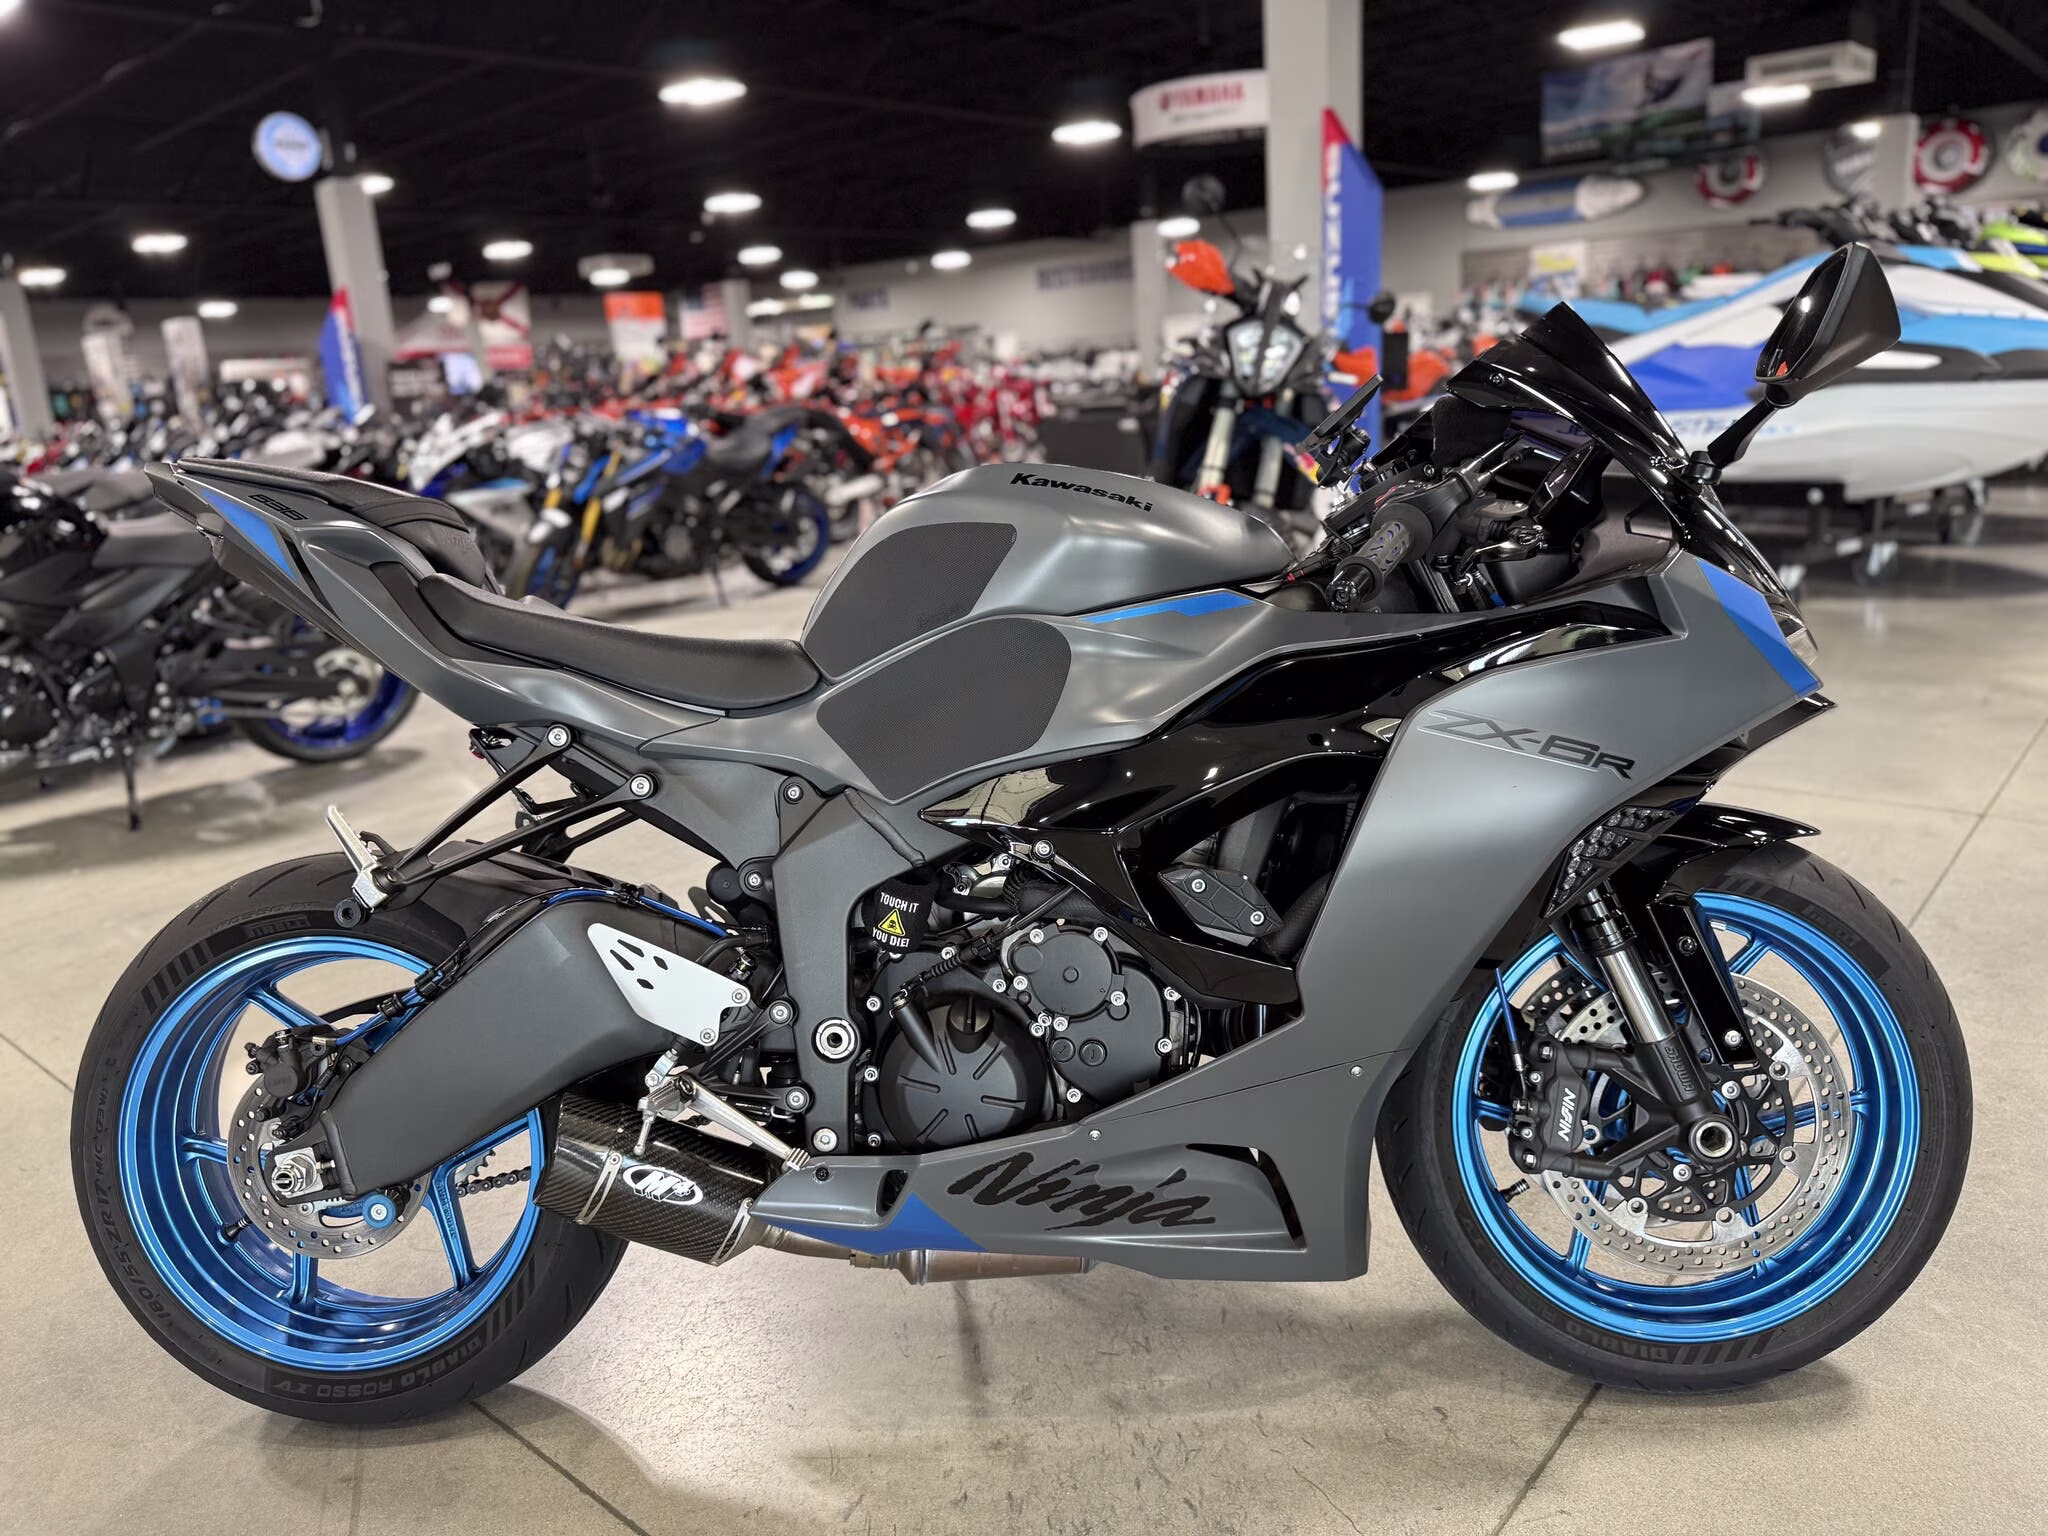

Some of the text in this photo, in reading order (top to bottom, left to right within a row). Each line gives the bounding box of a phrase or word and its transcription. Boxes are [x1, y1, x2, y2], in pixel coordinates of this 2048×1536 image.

[247, 493, 309, 522] 636
[1010, 473, 1153, 512] Kawasaki
[1423, 709, 1635, 780] ZX-6R
[880, 891, 919, 913] TOUCH IT
[872, 926, 910, 947] YOU DIE!
[1664, 1046, 1695, 1092] SHOWA
[947, 1151, 1217, 1232] Ninja
[398, 1333, 485, 1389] DIABLO
[316, 1375, 394, 1398] ROSSO
